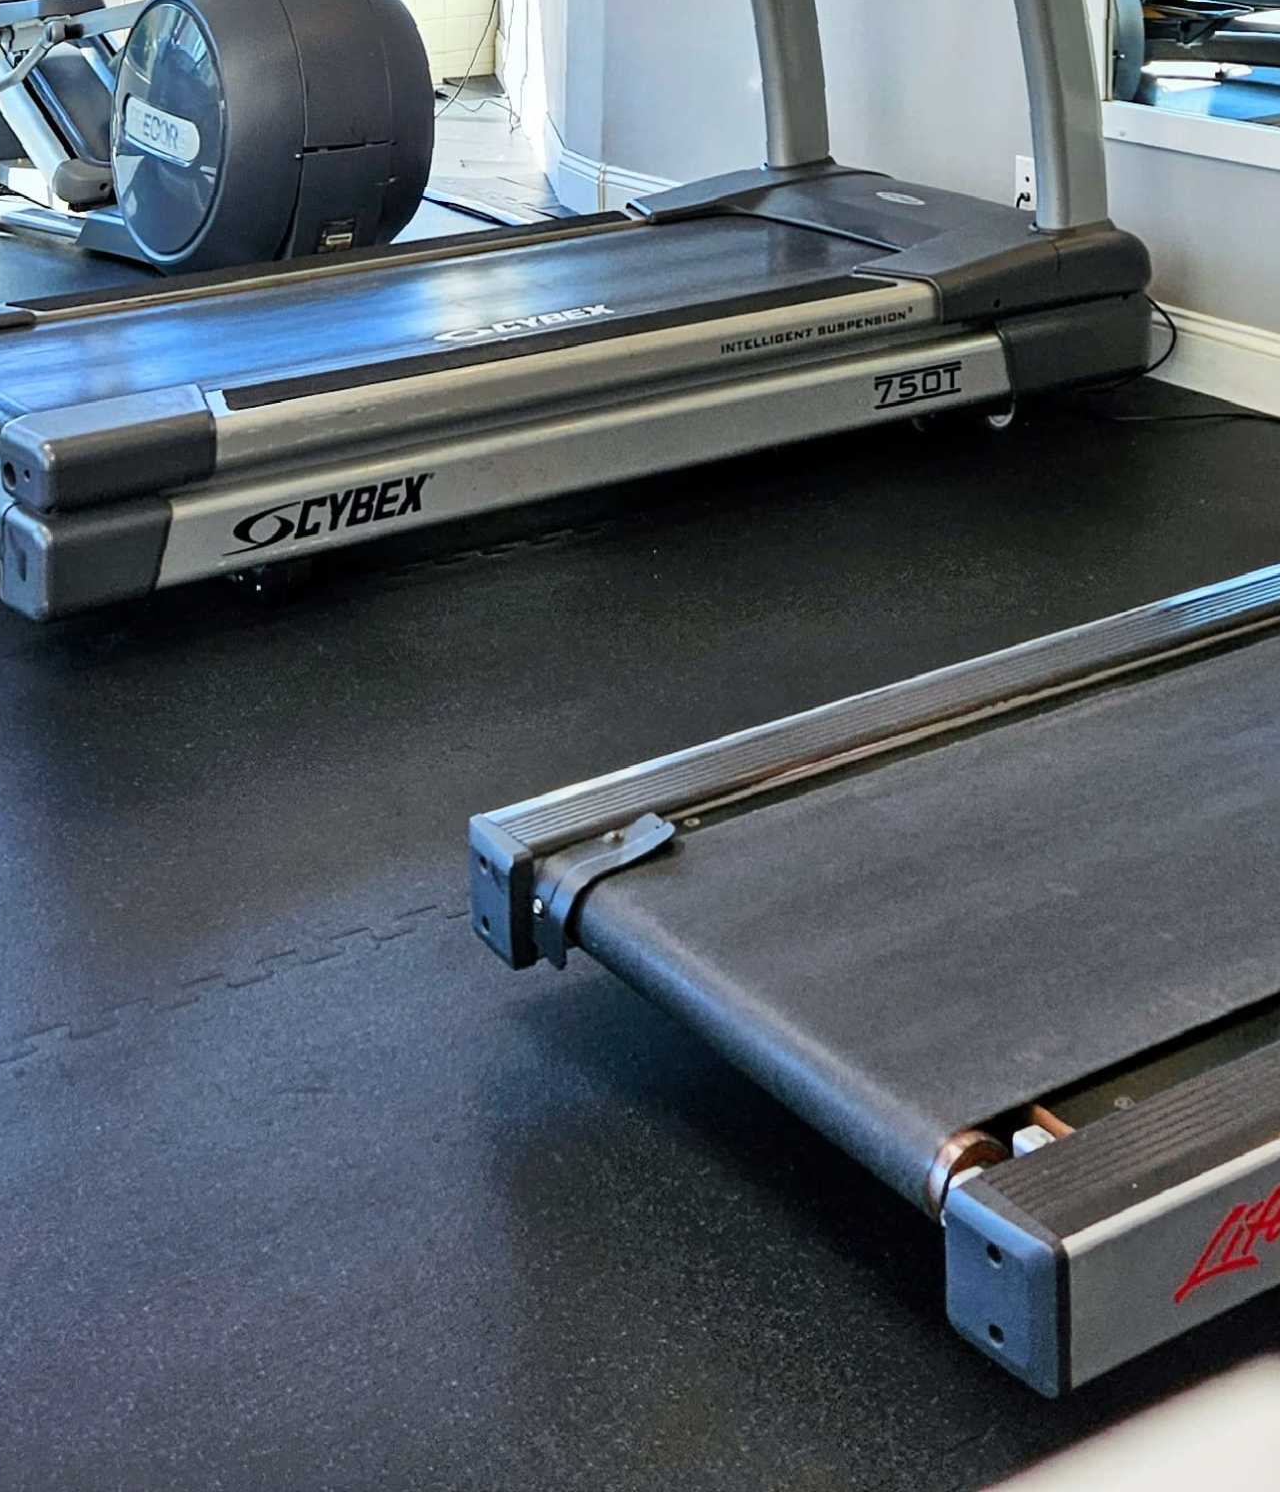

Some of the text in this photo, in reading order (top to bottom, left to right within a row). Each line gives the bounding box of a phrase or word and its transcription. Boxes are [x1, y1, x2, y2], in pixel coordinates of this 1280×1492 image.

[491, 304, 615, 334] CYBEX
[721, 310, 907, 355] INTELLIGENT SUSPENSION
[874, 365, 962, 405] 750T
[294, 473, 429, 540] CYBEX
